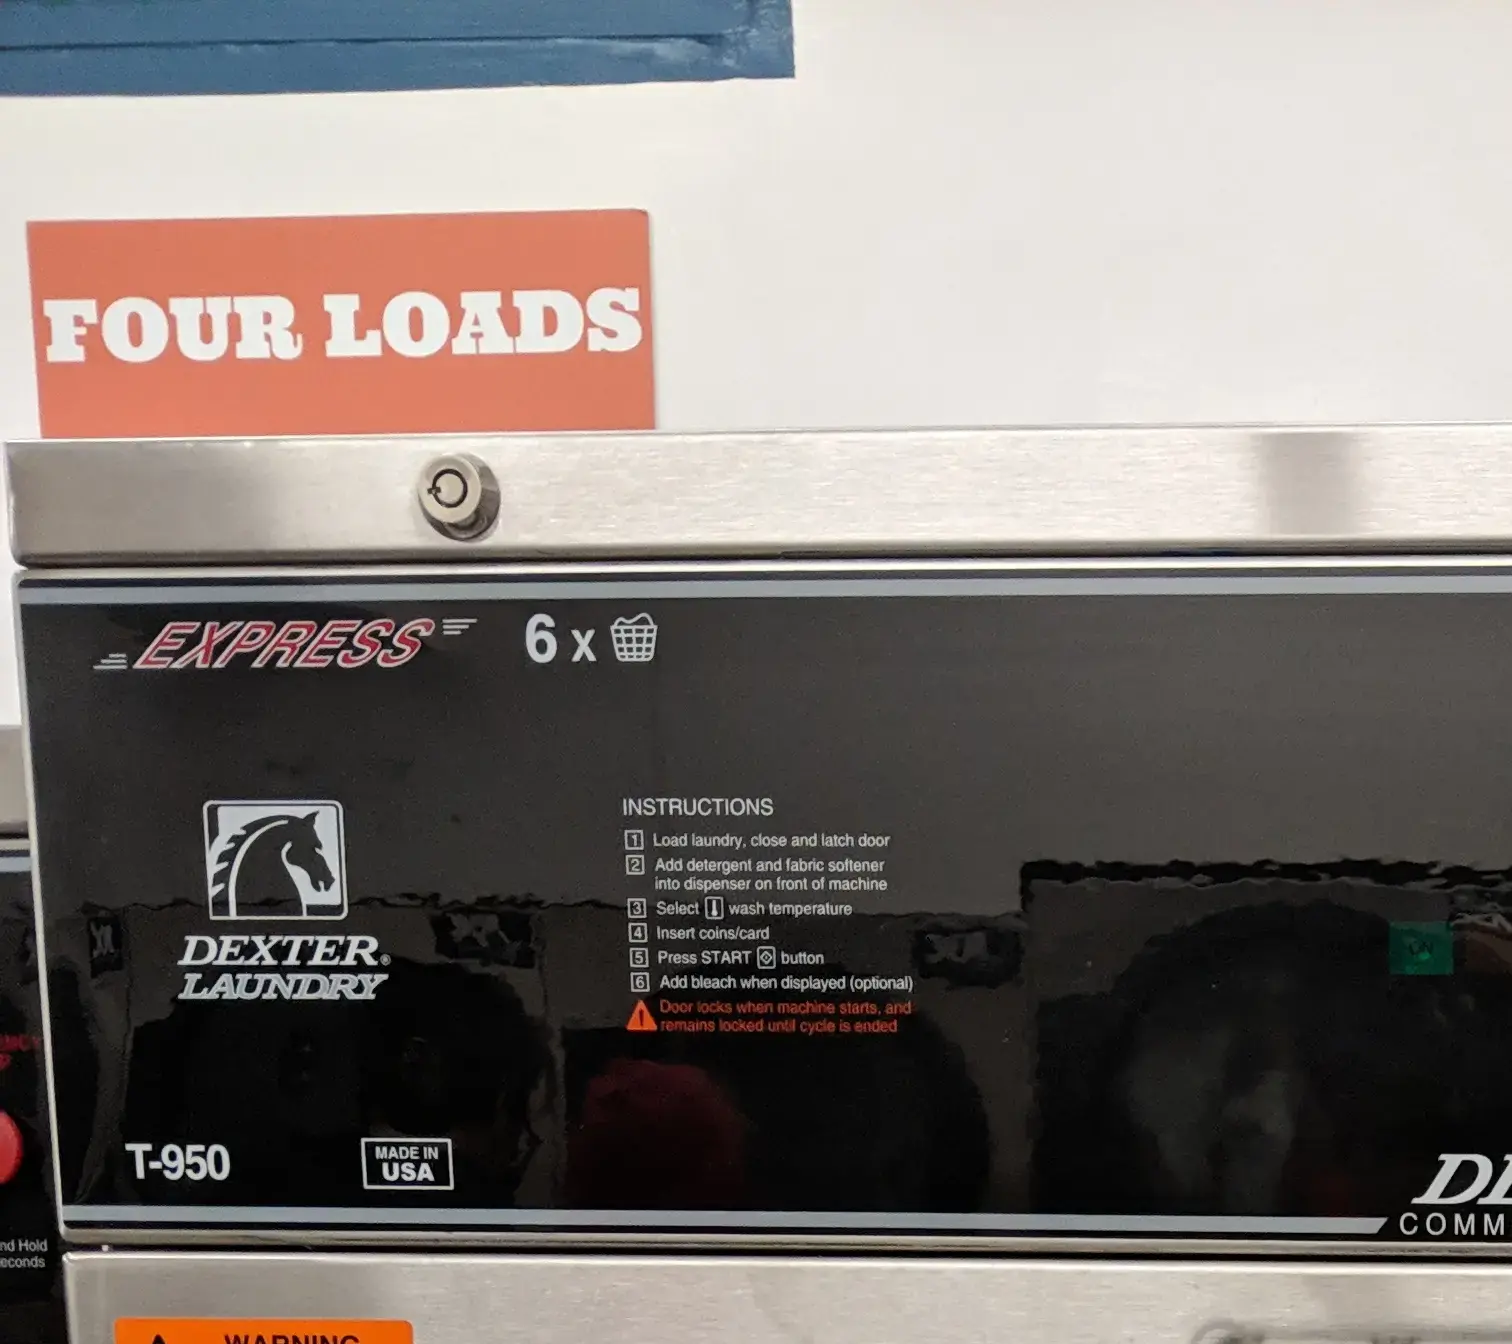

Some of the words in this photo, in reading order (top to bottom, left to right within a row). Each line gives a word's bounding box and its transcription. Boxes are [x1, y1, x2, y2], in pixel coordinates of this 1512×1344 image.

[44, 295, 302, 363] FOUR
[325, 287, 643, 359] LOADS
[134, 619, 435, 668] EXPRESS
[525, 613, 557, 664] 6
[623, 798, 774, 816] INSTRUCTIONS
[653, 834, 688, 846] Load
[692, 834, 746, 849] laundry,
[751, 834, 787, 846] close
[792, 834, 817, 846] and
[821, 834, 854, 846] latch
[859, 834, 890, 846] door
[655, 859, 683, 871] Add
[687, 859, 752, 875] detergent
[756, 859, 782, 871] and
[786, 859, 824, 871] fabric
[828, 859, 884, 871] softener
[655, 877, 680, 890] into
[684, 877, 751, 893] dispenser
[755, 879, 772, 890] on
[777, 877, 807, 890] front
[812, 877, 824, 890] of
[829, 877, 887, 890] machine
[657, 902, 699, 915] Select
[729, 902, 764, 915] wash
[769, 904, 852, 918] temperature
[657, 928, 695, 940] Insert
[699, 927, 769, 940] coins/card
[178, 935, 380, 966] DEXTER
[658, 952, 697, 964] Press
[701, 951, 752, 964] START
[781, 952, 824, 964] button
[178, 974, 388, 1000] LAUNDRY
[660, 976, 687, 989] Add
[692, 976, 736, 989] bleach
[741, 976, 777, 989] when
[781, 976, 845, 992] displayed
[850, 976, 913, 992] (optional)
[375, 1146, 414, 1160] MADE
[421, 1147, 439, 1160] IN
[125, 1143, 230, 1181] T-950
[382, 1162, 435, 1182] USA
